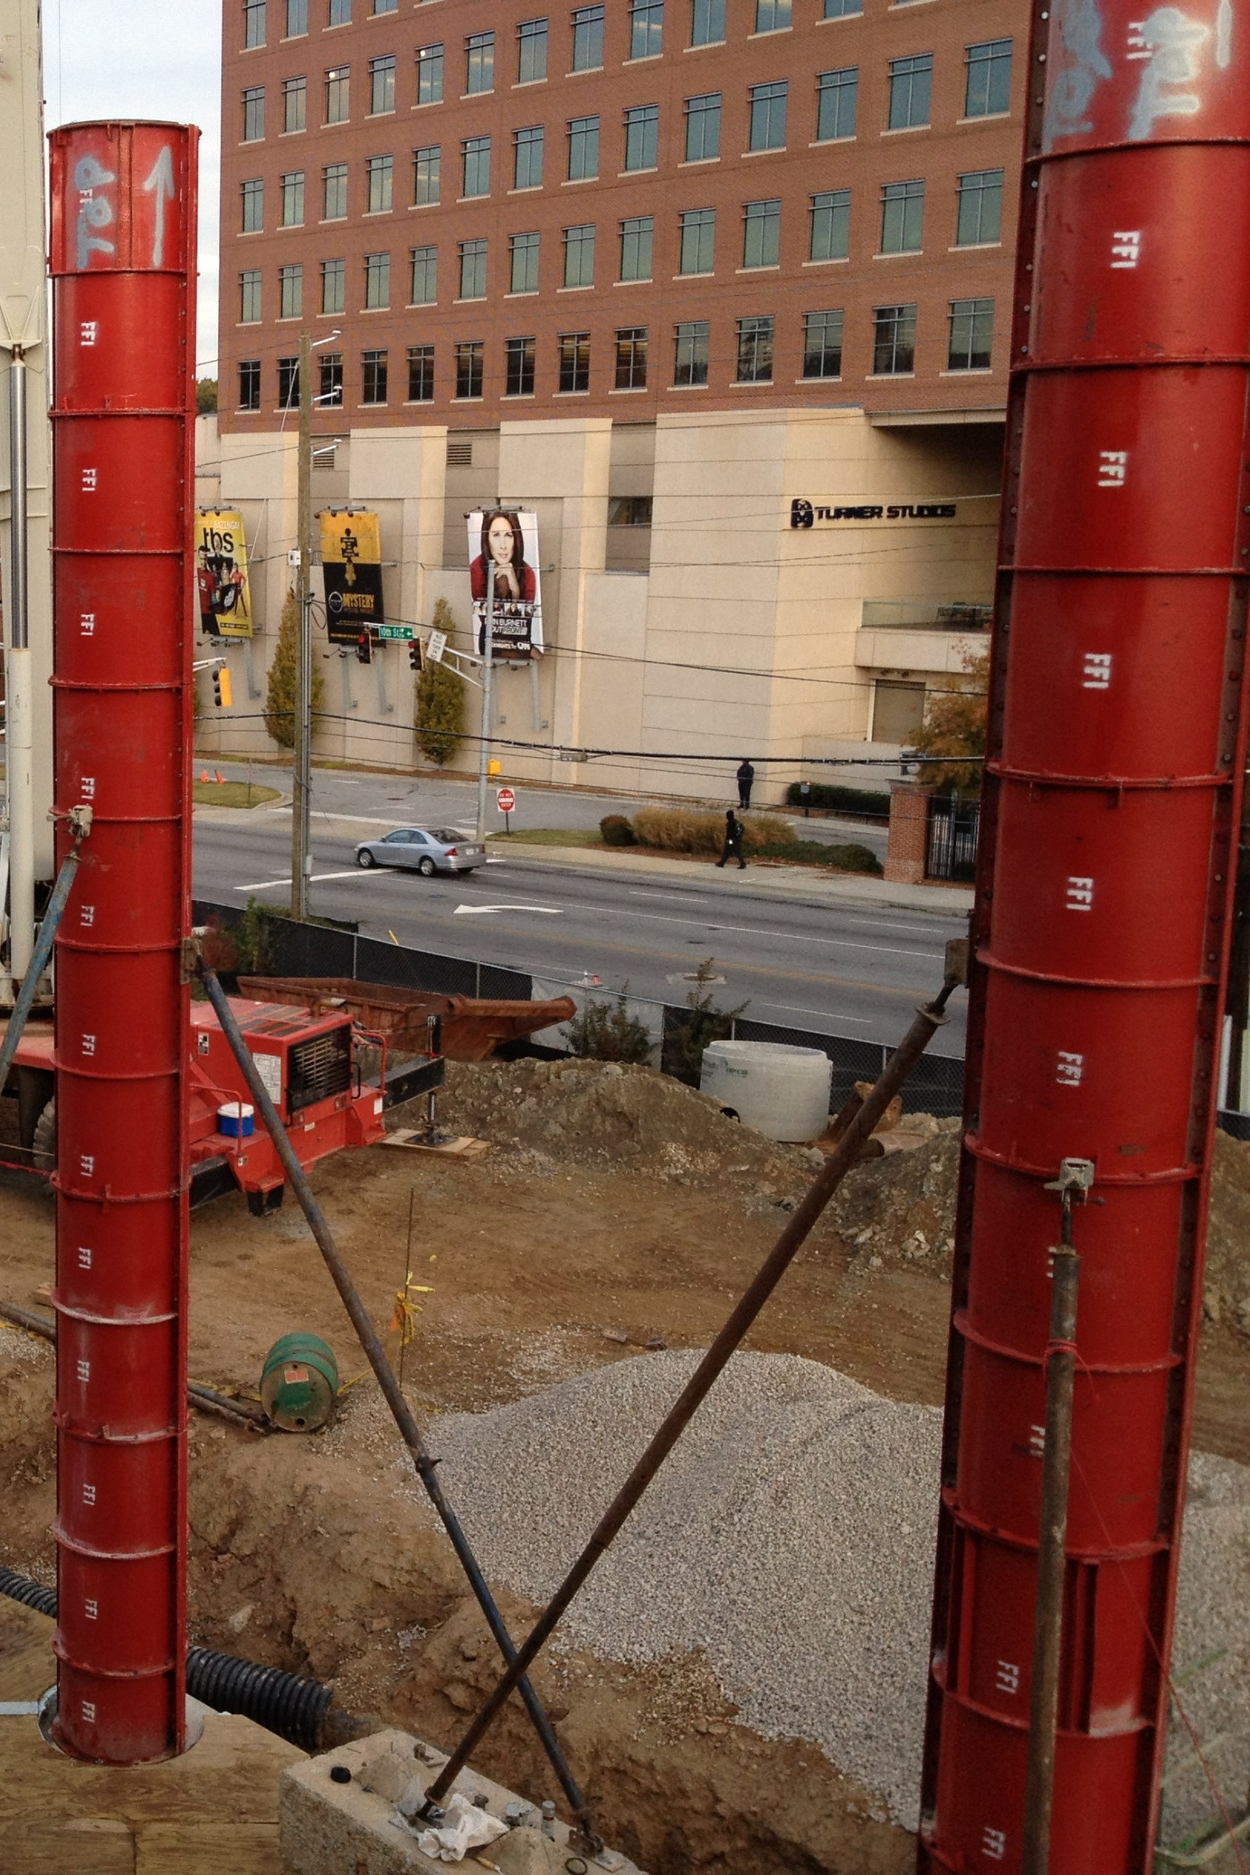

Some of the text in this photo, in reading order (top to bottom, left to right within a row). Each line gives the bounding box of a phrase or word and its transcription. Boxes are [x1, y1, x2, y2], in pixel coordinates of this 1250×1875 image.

[1111, 231, 1141, 269] FFI
[81, 322, 97, 346] FFI
[82, 469, 96, 492] FFI
[1098, 451, 1128, 487] FFI
[815, 504, 957, 520] TURNER STUDIOS
[203, 527, 234, 553] tbs
[343, 593, 374, 608] MYSTERY
[81, 614, 95, 636] FFI
[499, 618, 527, 627] BURNETT
[1083, 653, 1112, 690] FFI
[81, 778, 95, 801] FFI
[1066, 877, 1093, 912] FFI
[81, 906, 95, 927] FFI
[82, 1035, 96, 1056] FFI
[1056, 1051, 1084, 1087] FFI
[81, 1156, 95, 1177] FFI
[79, 1248, 92, 1270] FFI
[78, 1359, 91, 1383] FFI
[83, 1484, 96, 1506] FFI
[86, 1599, 98, 1620] FFI
[997, 1661, 1019, 1694] FFI
[83, 1701, 96, 1723] FFI
[983, 1828, 1005, 1858] FFI
